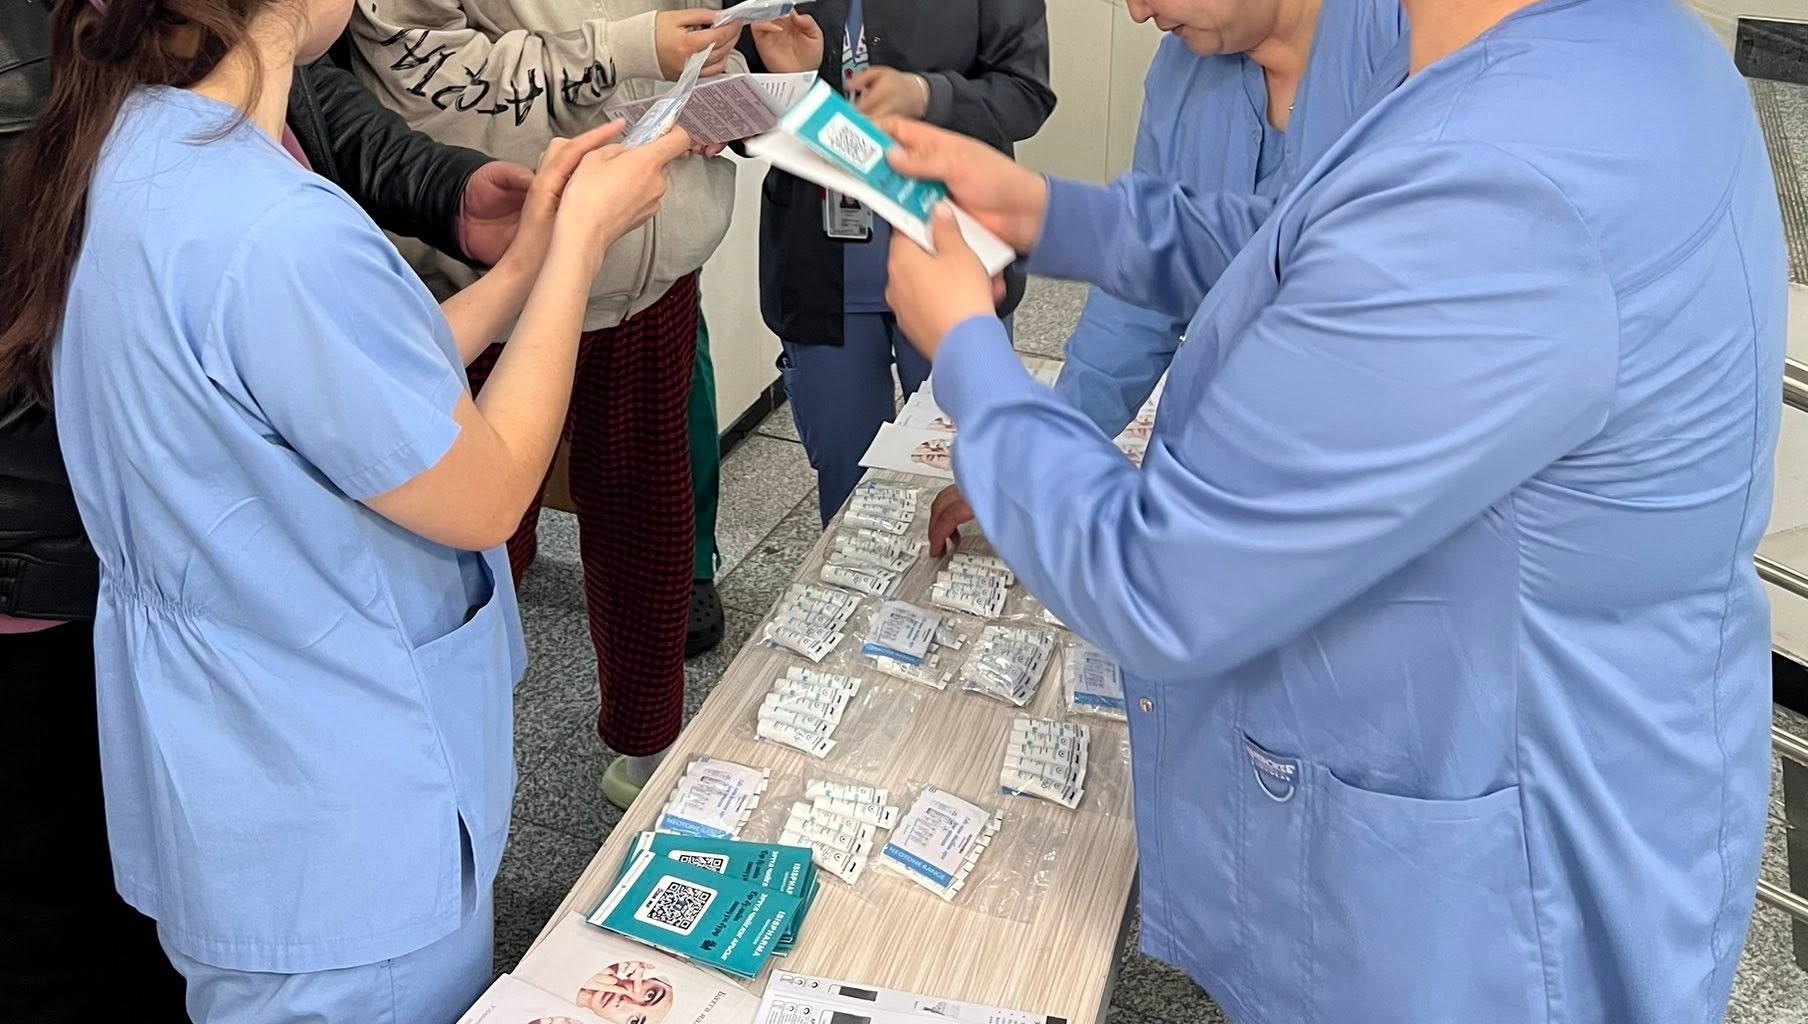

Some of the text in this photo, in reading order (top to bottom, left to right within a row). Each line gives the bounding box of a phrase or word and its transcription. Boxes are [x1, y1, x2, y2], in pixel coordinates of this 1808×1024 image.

[888, 846, 945, 880] NEOTONE RANGE
[751, 909, 786, 958] ISISPHARMA
